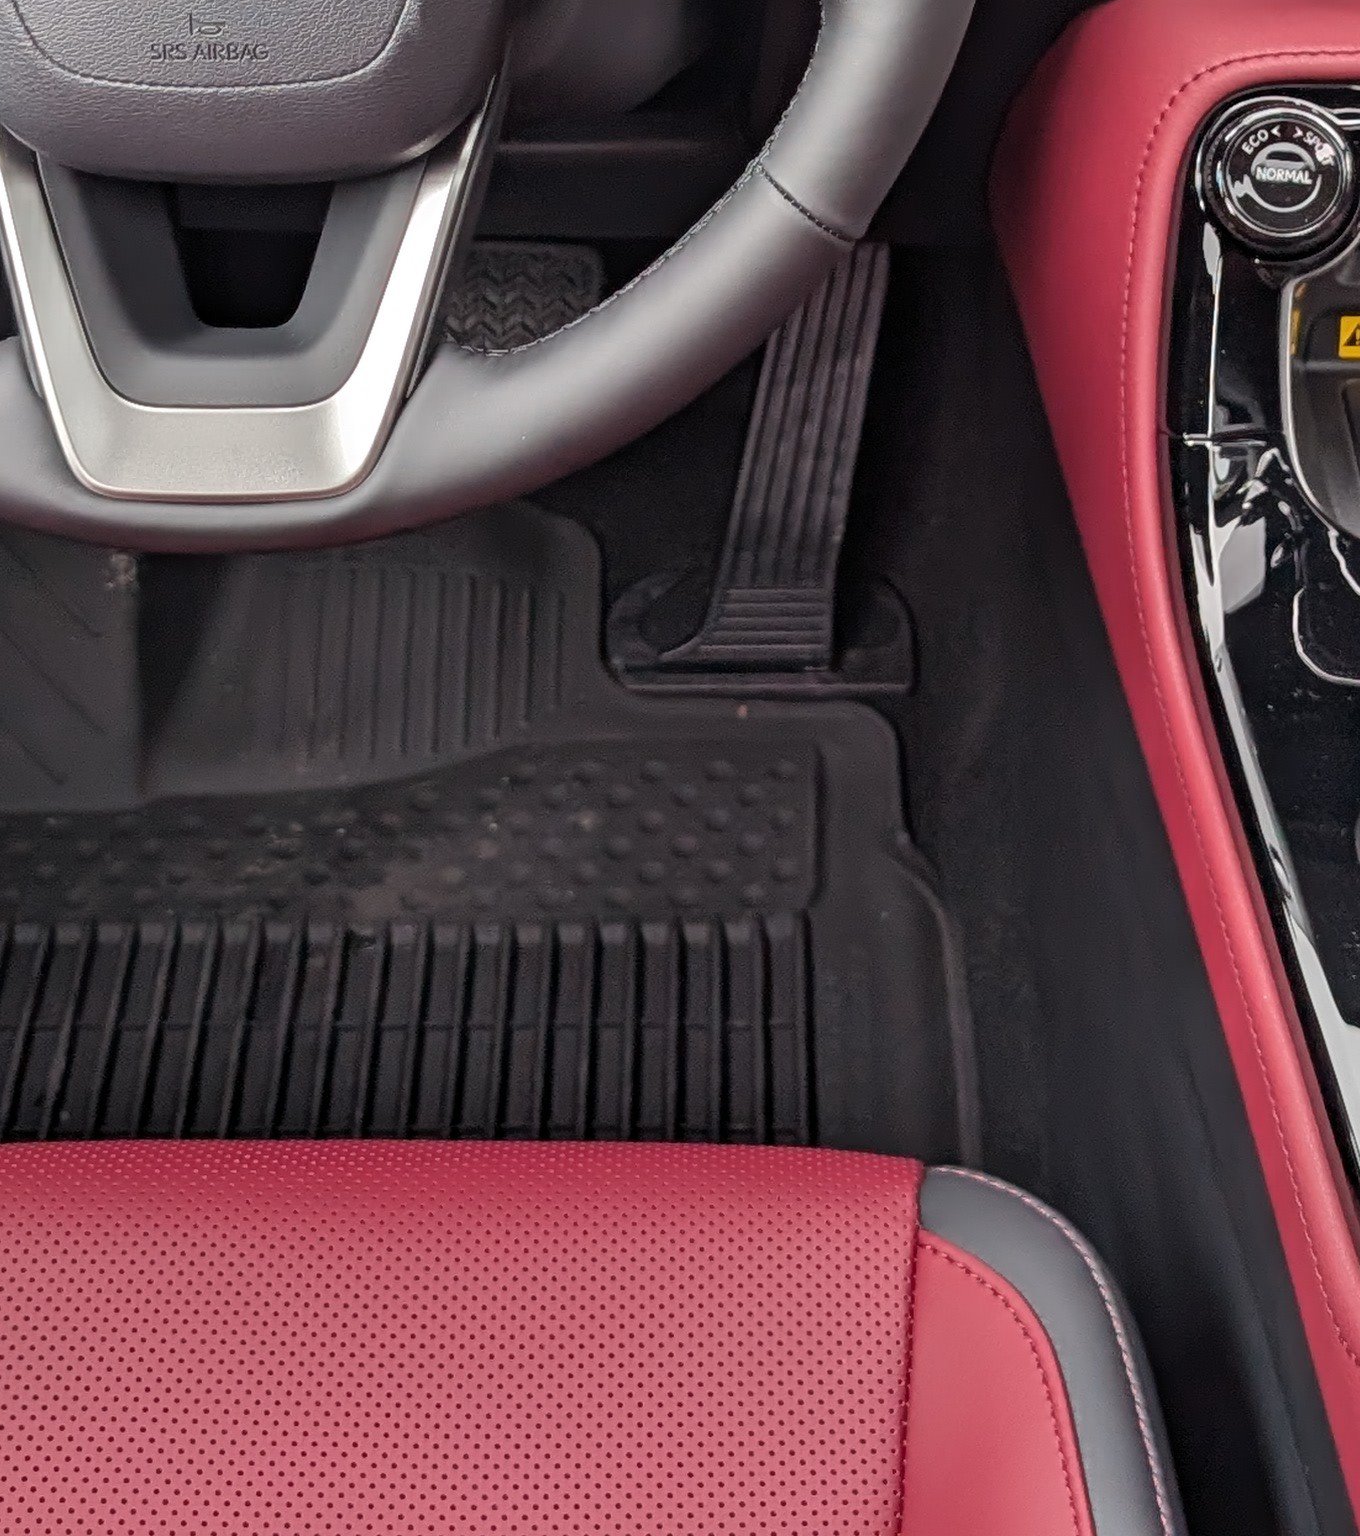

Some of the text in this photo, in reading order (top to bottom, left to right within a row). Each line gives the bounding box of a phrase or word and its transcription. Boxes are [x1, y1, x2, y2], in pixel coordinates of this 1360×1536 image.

[149, 41, 270, 63] SRS AIRBAG
[1241, 128, 1270, 156] ECO
[1302, 130, 1337, 166] SPORT
[1254, 165, 1313, 185] NORMAL
